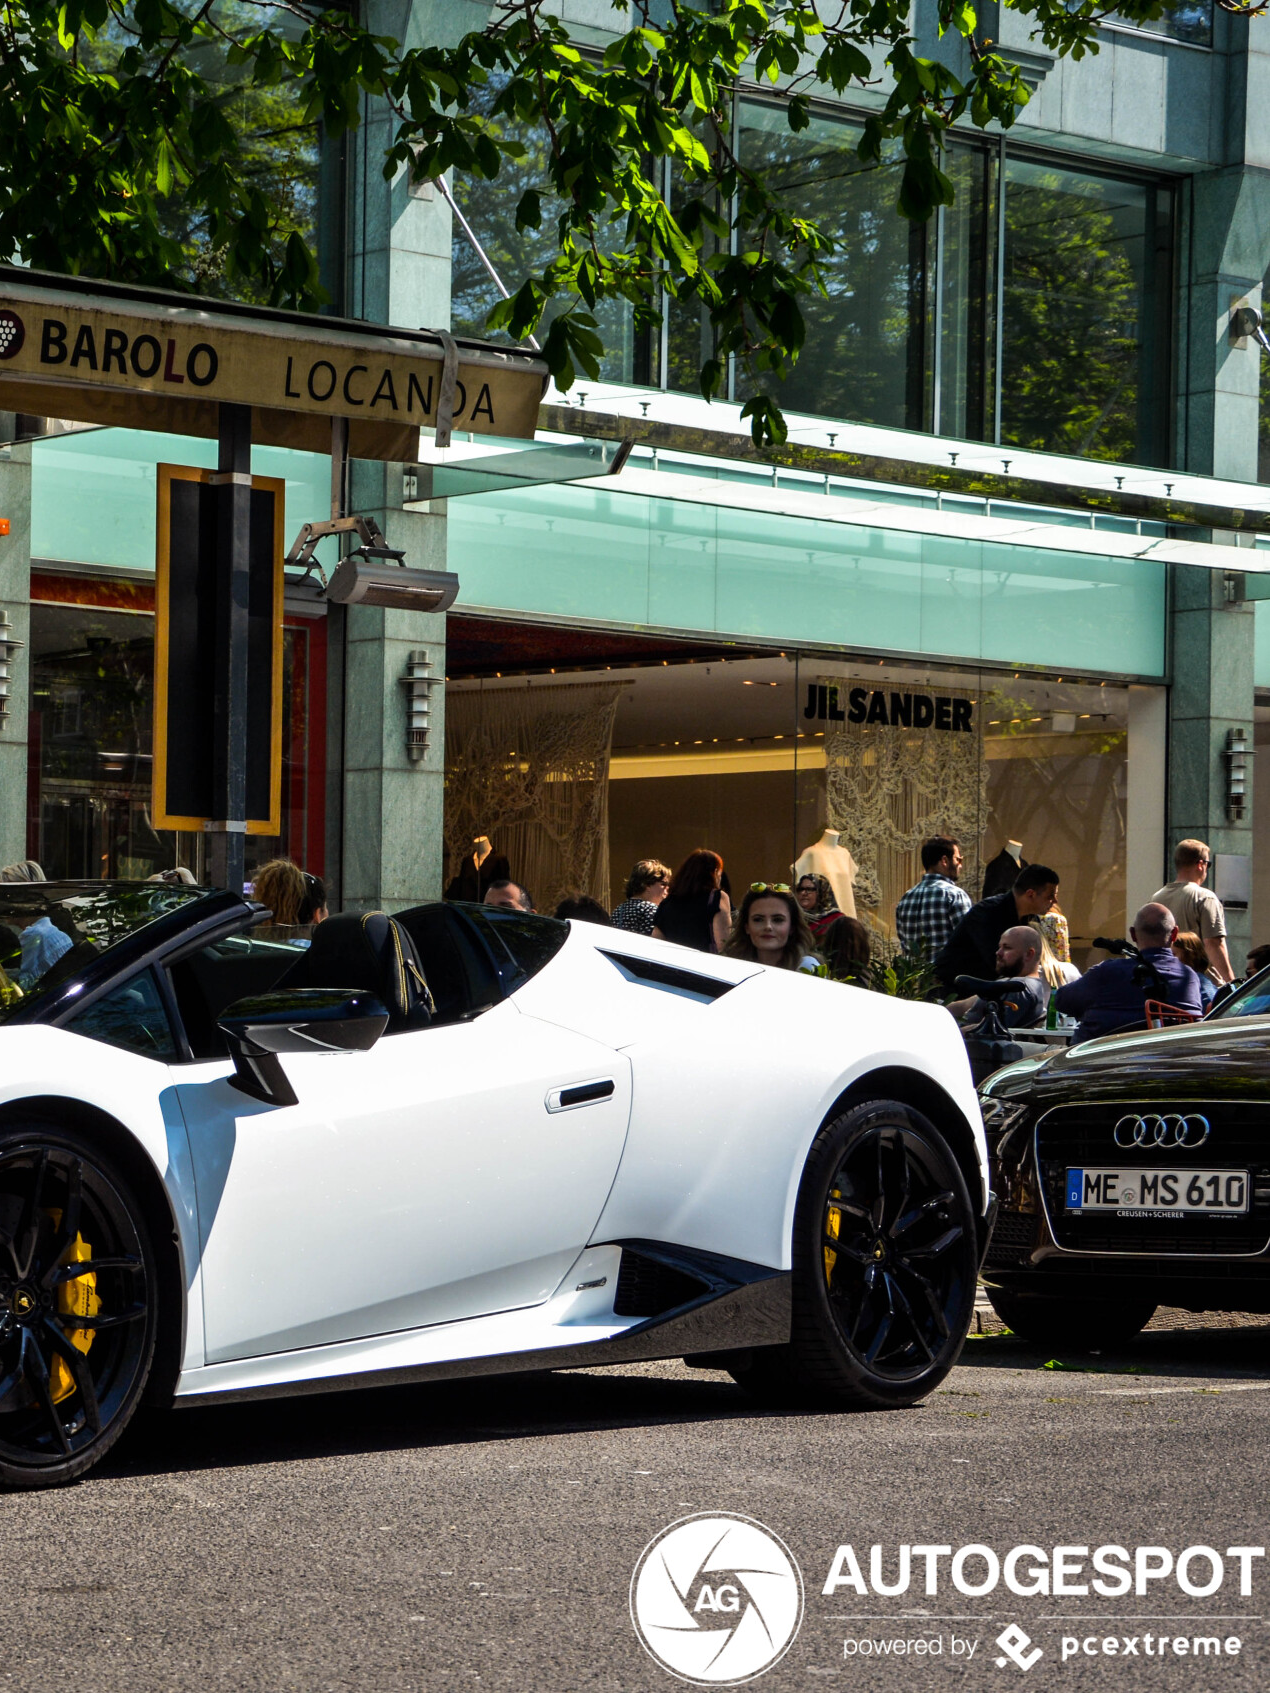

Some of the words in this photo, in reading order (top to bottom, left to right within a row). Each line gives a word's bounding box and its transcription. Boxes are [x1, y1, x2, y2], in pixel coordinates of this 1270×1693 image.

[40, 318, 219, 387] BAROLO
[804, 684, 846, 722] JIL
[847, 687, 973, 733] SANDER
[1083, 1173, 1120, 1206] ME
[1139, 1174, 1179, 1206] MS
[1185, 1175, 1245, 1208] 610
[1116, 1210, 1185, 1218] CREUSEN+SCHERER
